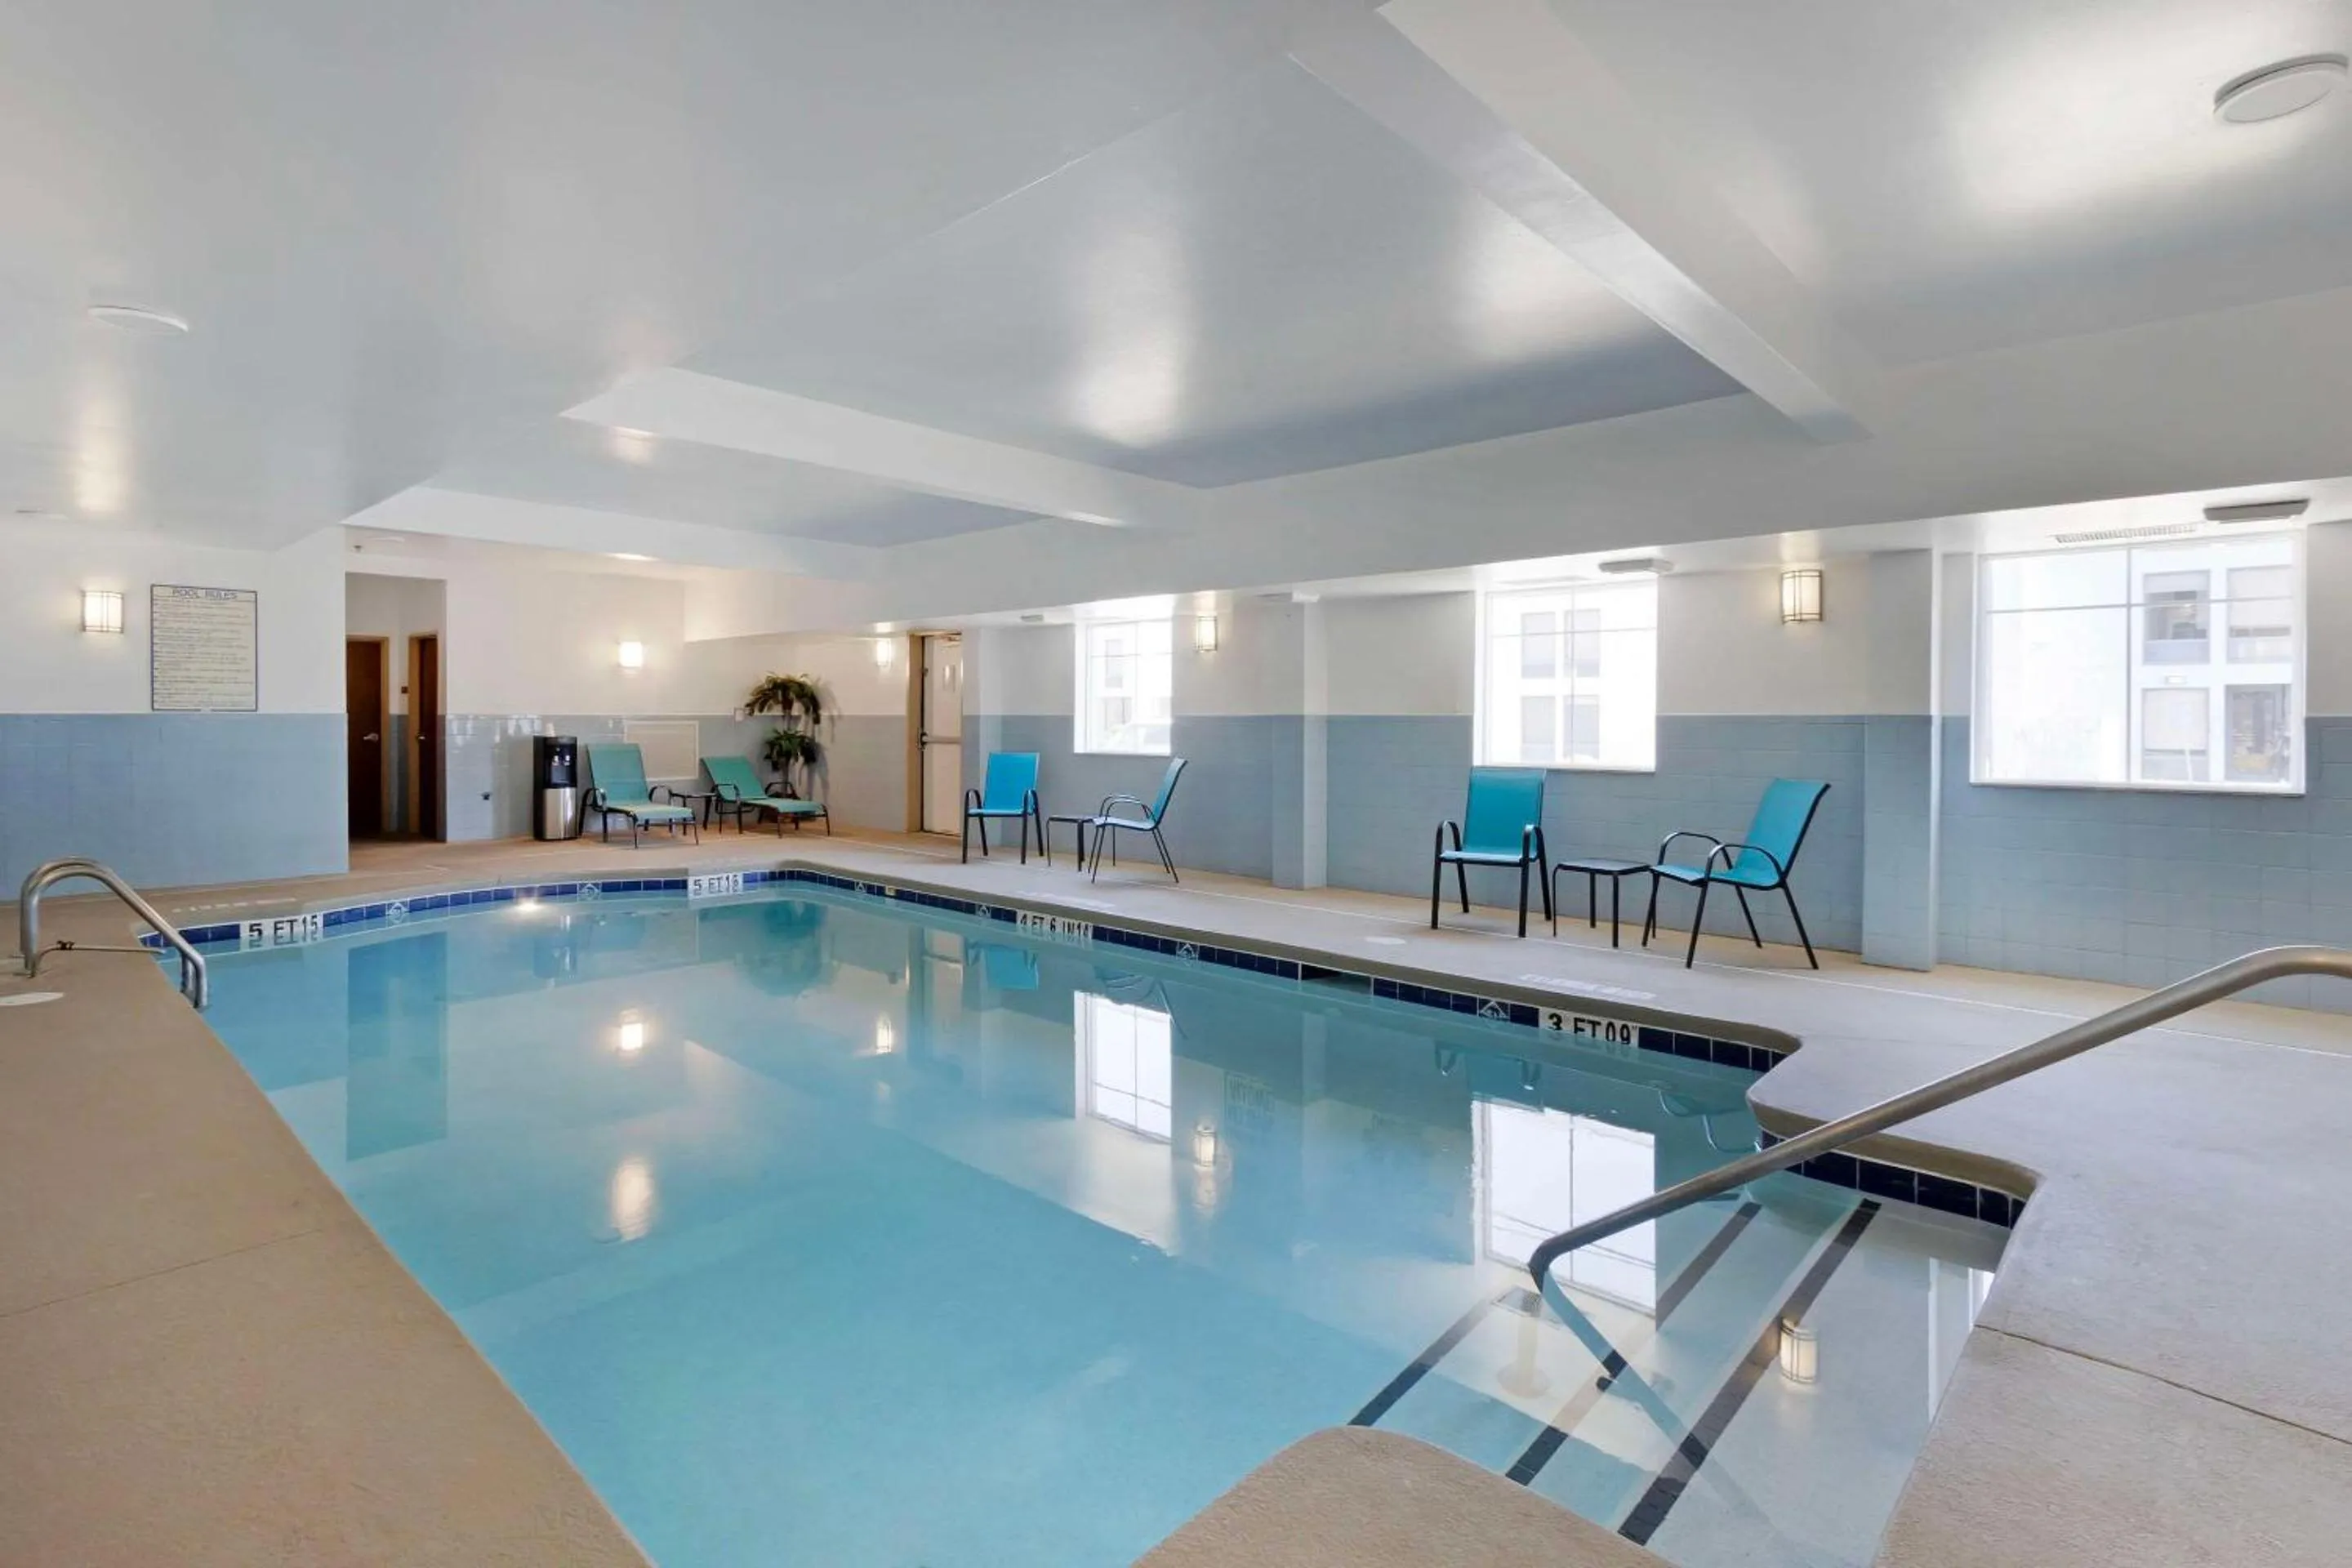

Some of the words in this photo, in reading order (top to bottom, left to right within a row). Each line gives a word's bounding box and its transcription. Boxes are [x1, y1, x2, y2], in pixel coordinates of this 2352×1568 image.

[172, 588, 201, 599] POOL
[205, 589, 238, 601] RULES
[693, 878, 702, 891] 5
[708, 876, 723, 890] FT
[248, 922, 263, 938] 5
[274, 918, 298, 936] FT
[1049, 916, 1057, 933] 6
[1548, 1013, 1563, 1031] 3
[1573, 1017, 1602, 1039] FT
